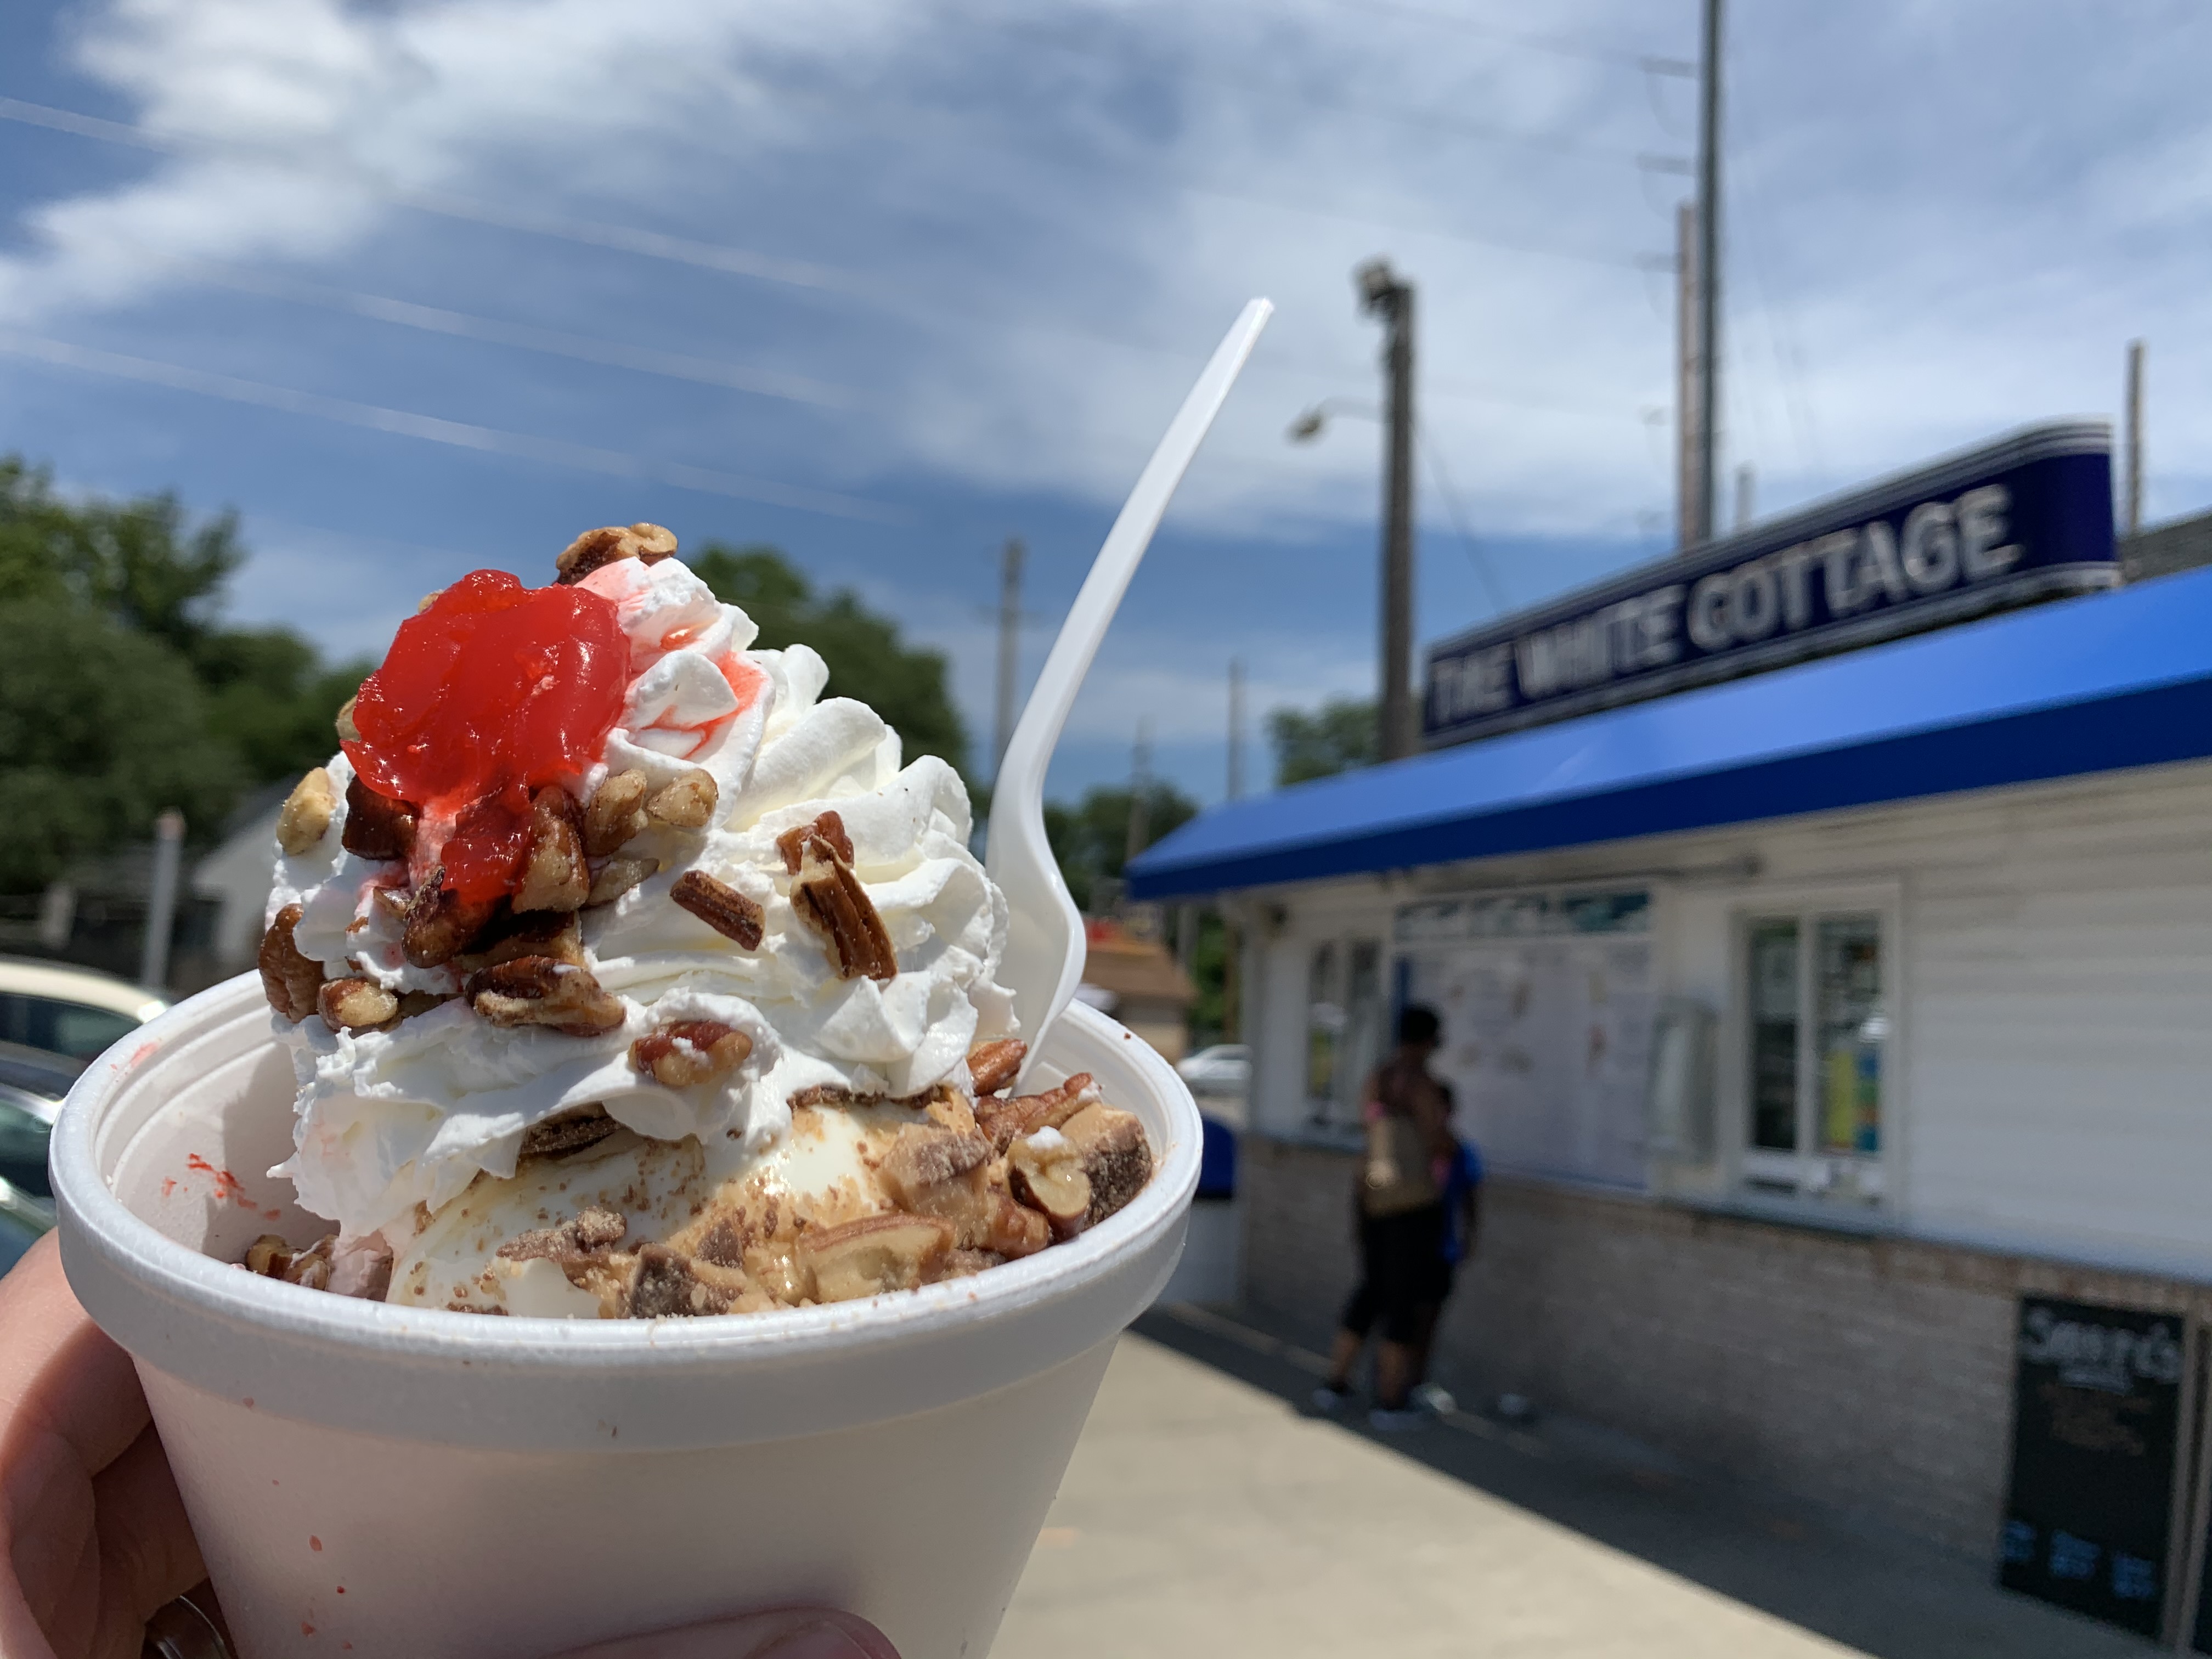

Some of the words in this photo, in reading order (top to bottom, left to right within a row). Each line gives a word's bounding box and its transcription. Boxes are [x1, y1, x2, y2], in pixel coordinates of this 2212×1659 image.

[1430, 640, 1512, 726] THE
[1513, 583, 1686, 699] WHITE
[1687, 484, 2023, 650] COTTAGE
